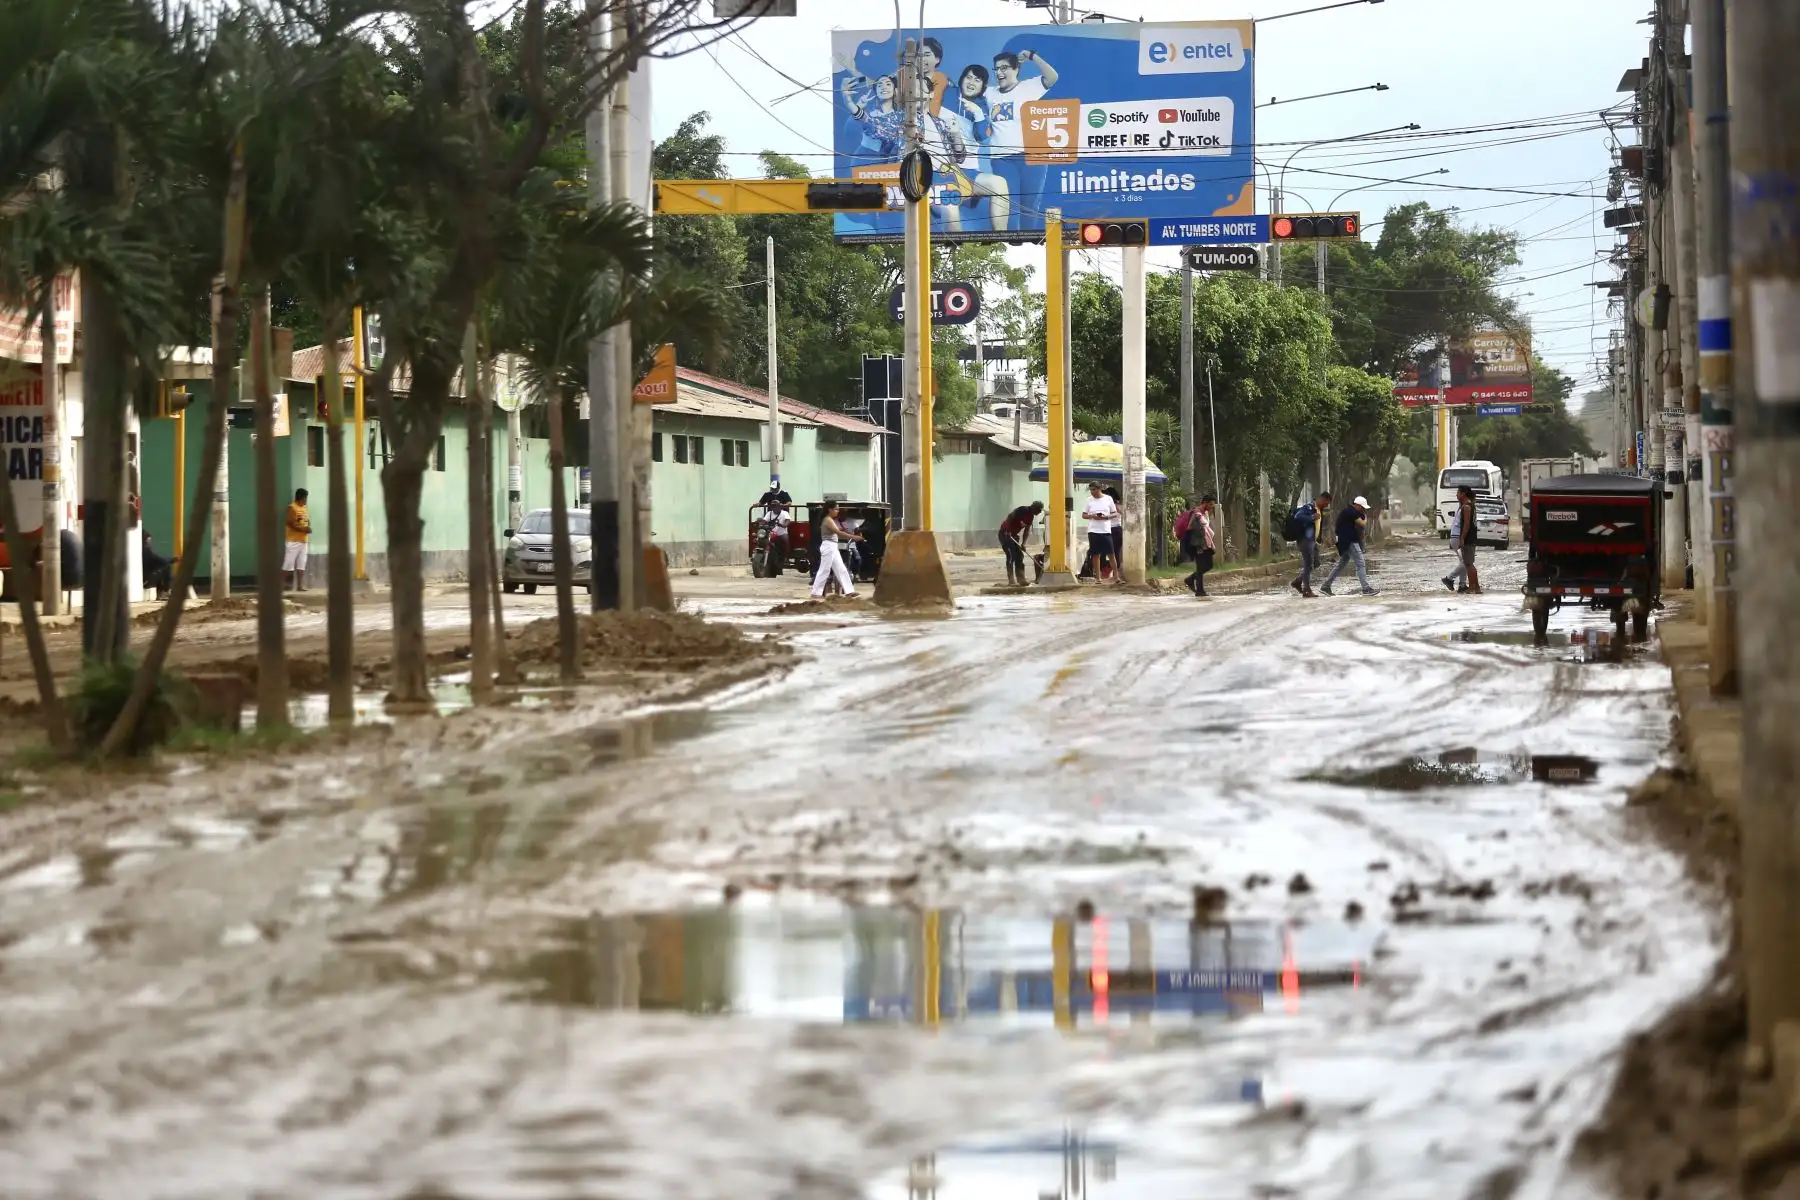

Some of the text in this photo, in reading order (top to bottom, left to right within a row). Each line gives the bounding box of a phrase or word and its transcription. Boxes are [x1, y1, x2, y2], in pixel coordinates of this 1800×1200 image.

[1183, 43, 1233, 59] entel
[1030, 106, 1068, 116] Recarga
[1109, 109, 1221, 124] Spotify YouTube
[1087, 134, 1118, 148] FREE
[1178, 134, 1220, 147] TikTok
[1060, 168, 1196, 194] ilimitados
[1121, 194, 1126, 202] 3
[1162, 222, 1257, 238] AV. TUMBES NORTE
[1193, 253, 1254, 265] TUM-001
